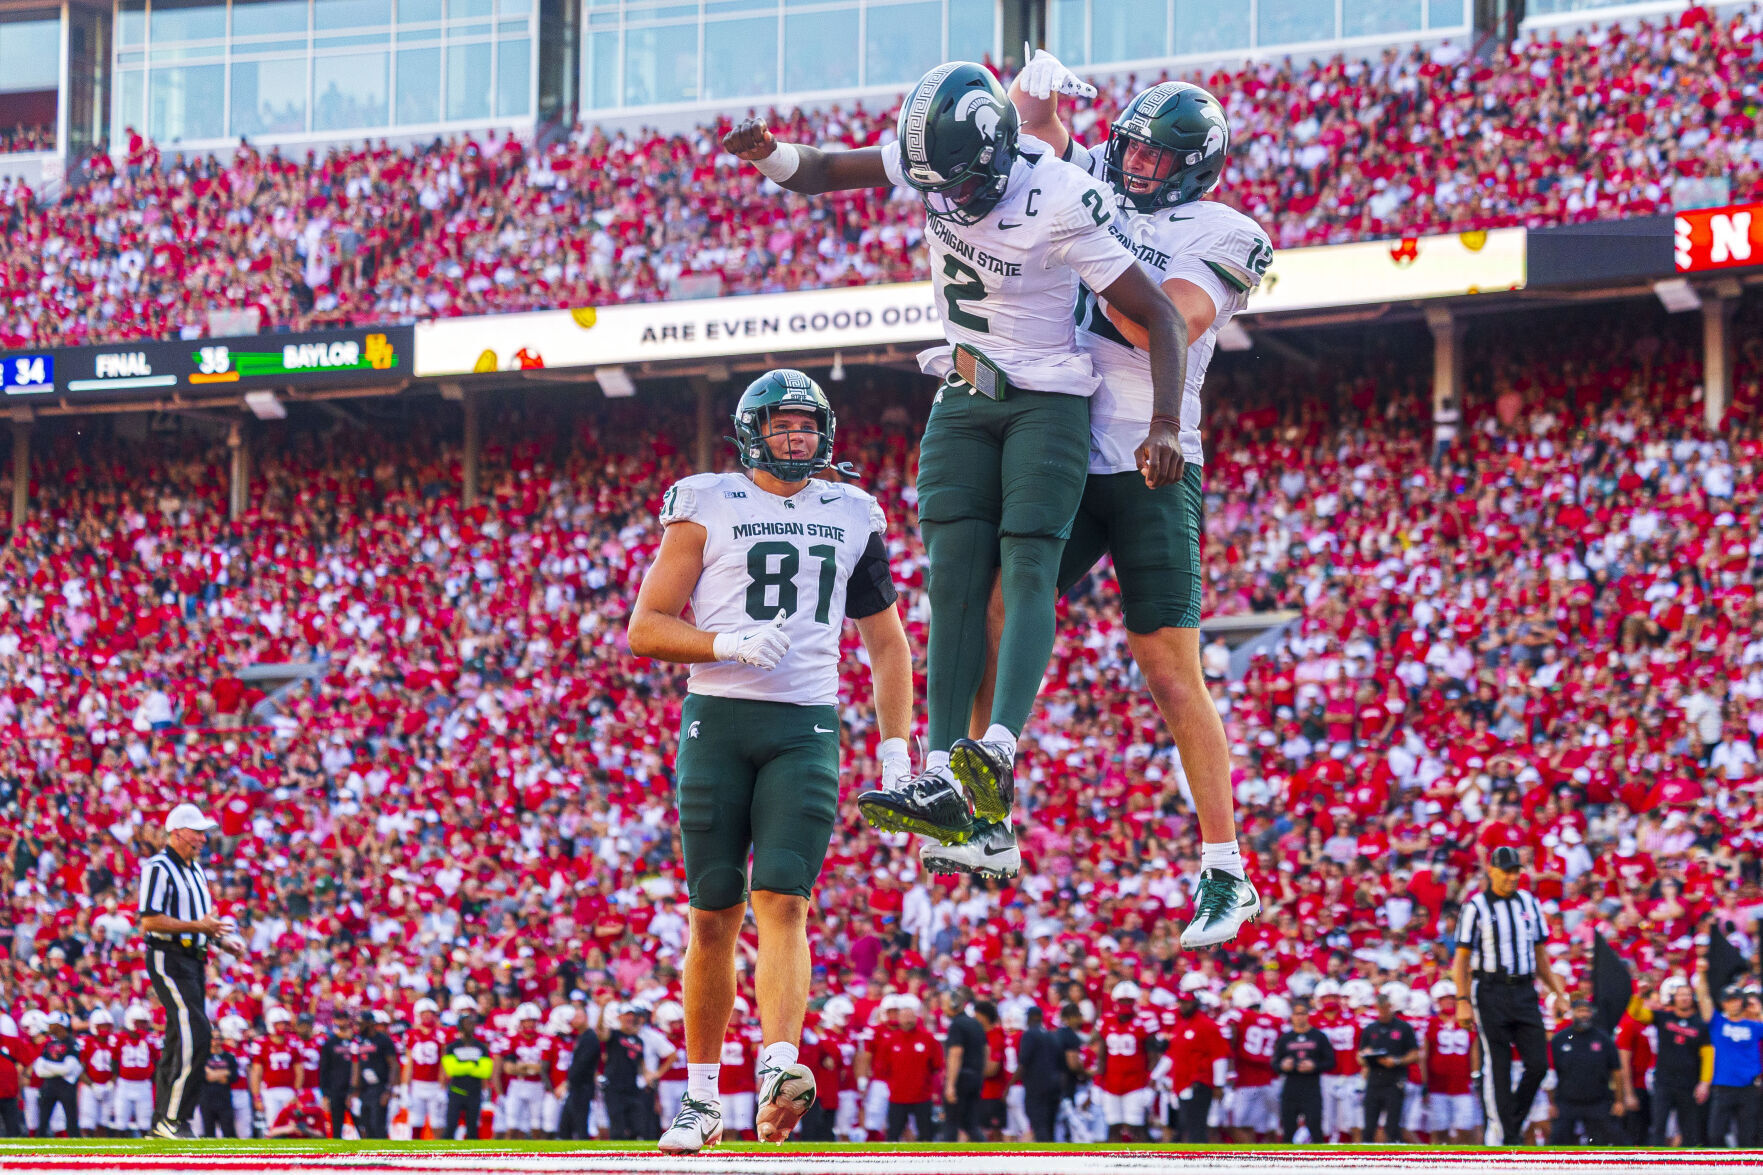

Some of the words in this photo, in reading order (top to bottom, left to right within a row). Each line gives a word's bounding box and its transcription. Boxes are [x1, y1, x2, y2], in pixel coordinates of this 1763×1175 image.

[1026, 188, 1042, 217] C
[1081, 188, 1111, 227] 2
[927, 211, 976, 261] MICHIGAN
[976, 251, 1022, 277] STATE
[1246, 237, 1273, 276] 12
[1710, 211, 1752, 263] N
[943, 253, 990, 334] 2
[641, 323, 696, 345] ARE
[705, 316, 780, 341] EVEN
[788, 308, 873, 333] GOOD
[15, 357, 46, 386] 34
[95, 351, 152, 378] FINAL
[199, 346, 231, 374] 35
[283, 340, 360, 369] BAYLOR
[732, 522, 804, 540] MICHIGAN
[807, 523, 845, 543] STATE
[745, 540, 837, 625] 81
